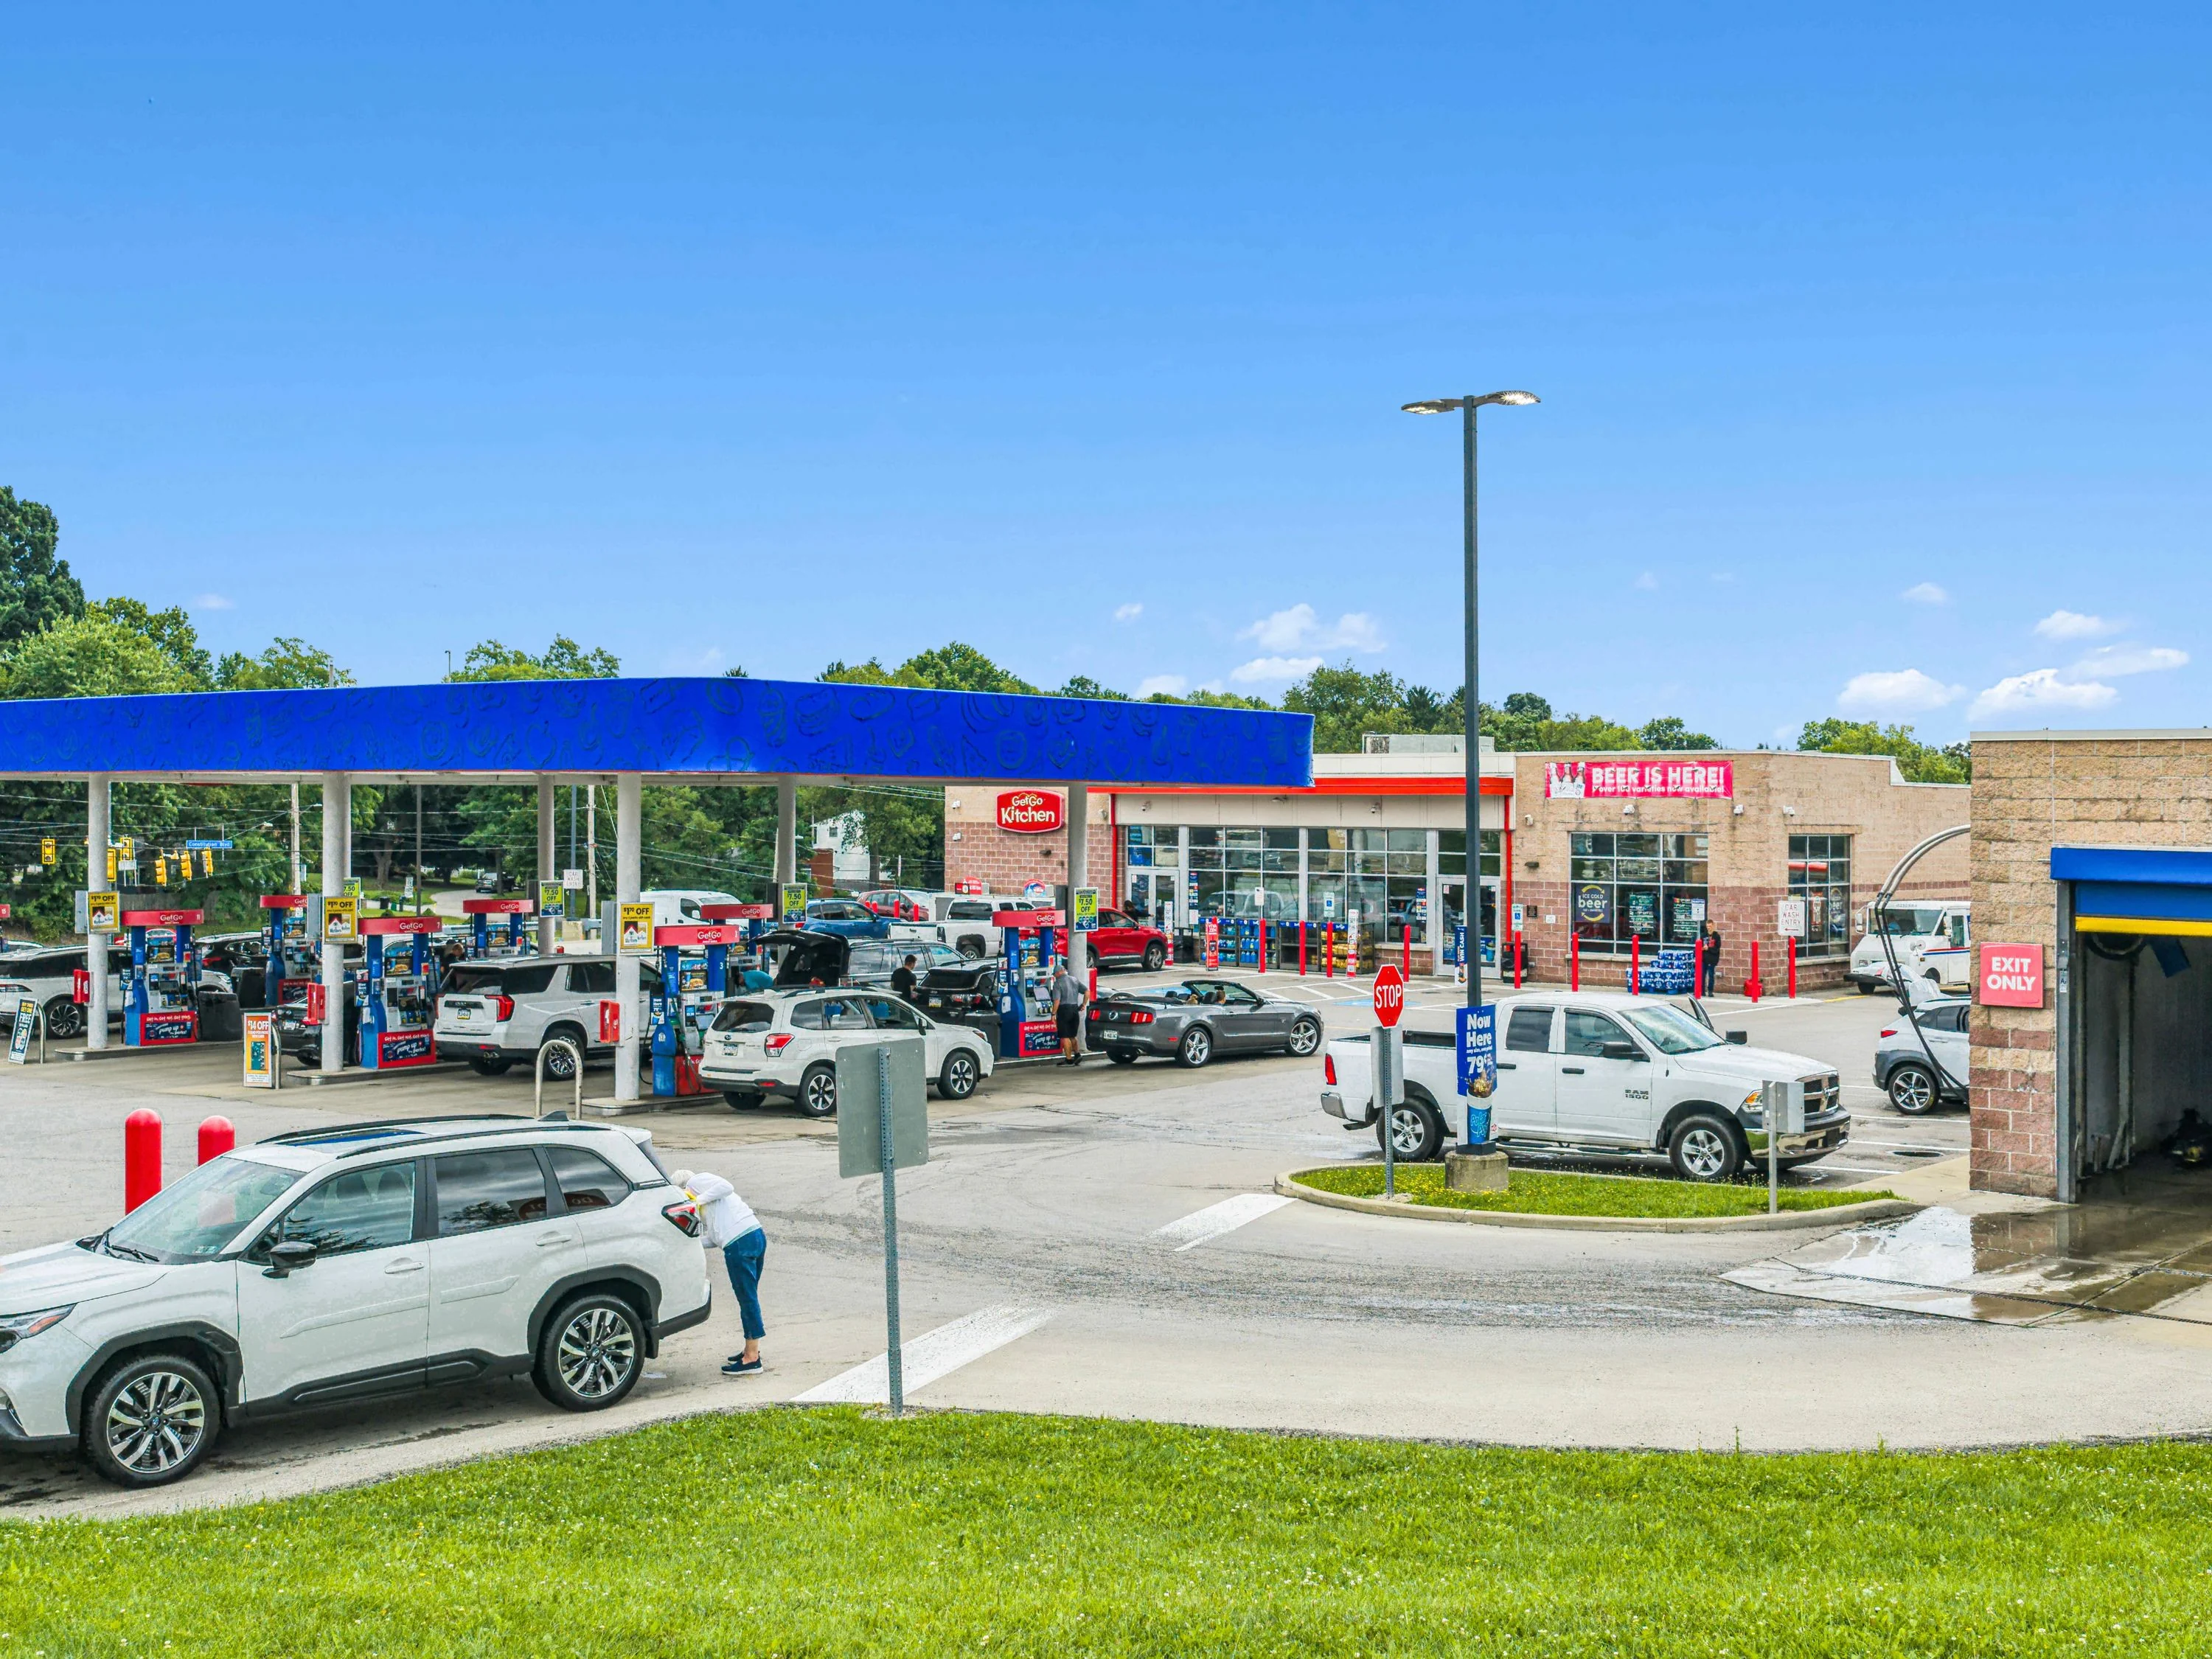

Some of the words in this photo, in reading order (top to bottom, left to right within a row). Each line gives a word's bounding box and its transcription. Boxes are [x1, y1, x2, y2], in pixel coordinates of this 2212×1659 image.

[1592, 768, 1638, 784] BEER
[1645, 768, 1662, 784] IS
[1668, 767, 1724, 784] HERE!
[1012, 796, 1043, 807] GetGo
[1001, 807, 1055, 824] Kitchen
[1578, 895, 1607, 908] beer
[636, 907, 650, 915] OFF
[698, 931, 722, 940] GetGo
[1992, 957, 2031, 973] EXIT
[1986, 975, 2036, 991] ONLY
[1376, 984, 1402, 1009] STOP
[19, 1012, 32, 1023] FREE
[257, 1020, 268, 1030] OFF
[1467, 1014, 1491, 1030] Now
[1466, 1032, 1492, 1047] Here
